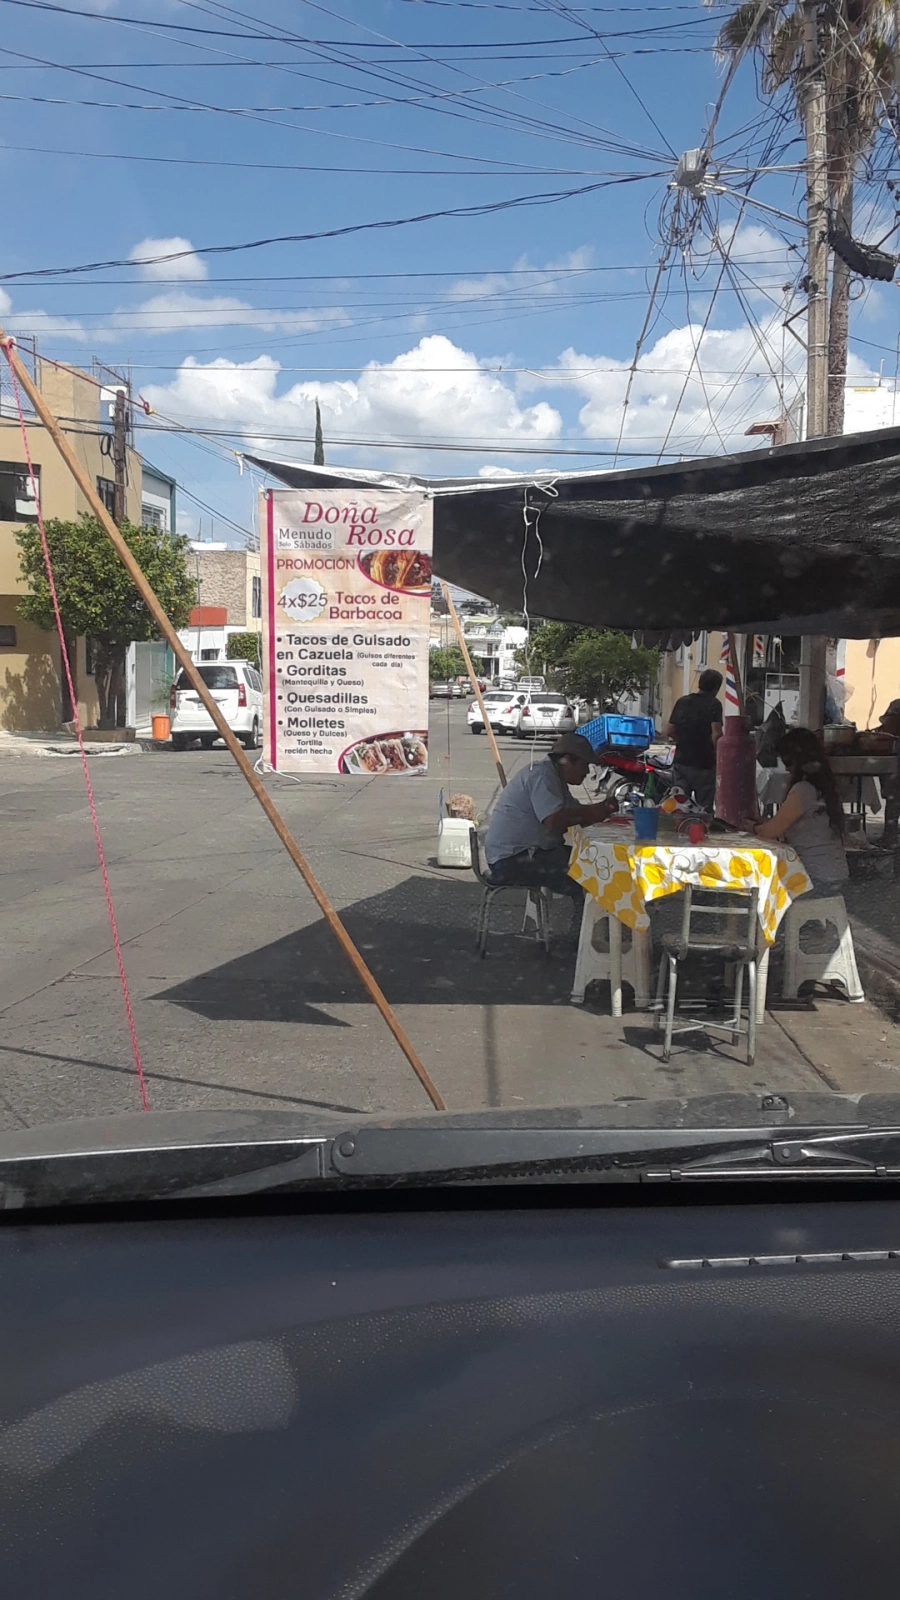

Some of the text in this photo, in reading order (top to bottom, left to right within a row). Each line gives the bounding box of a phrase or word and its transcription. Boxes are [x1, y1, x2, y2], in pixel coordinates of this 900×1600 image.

[302, 502, 378, 524] Doña
[279, 529, 332, 539] Menudo
[346, 525, 415, 546] Rosa
[294, 541, 332, 549] Sábados
[277, 557, 355, 569] PROMOCIÓN
[277, 594, 328, 608] 4x$25
[335, 592, 399, 604] Tacos de
[330, 607, 402, 619] Barbacoa
[286, 634, 411, 646] Tacos de Guisado
[277, 649, 353, 660] en Cazuela
[287, 665, 346, 676] Gorditas
[287, 693, 368, 704] Quesadillas
[287, 718, 345, 728] Molletes
[319, 730, 347, 738] Dulces)
